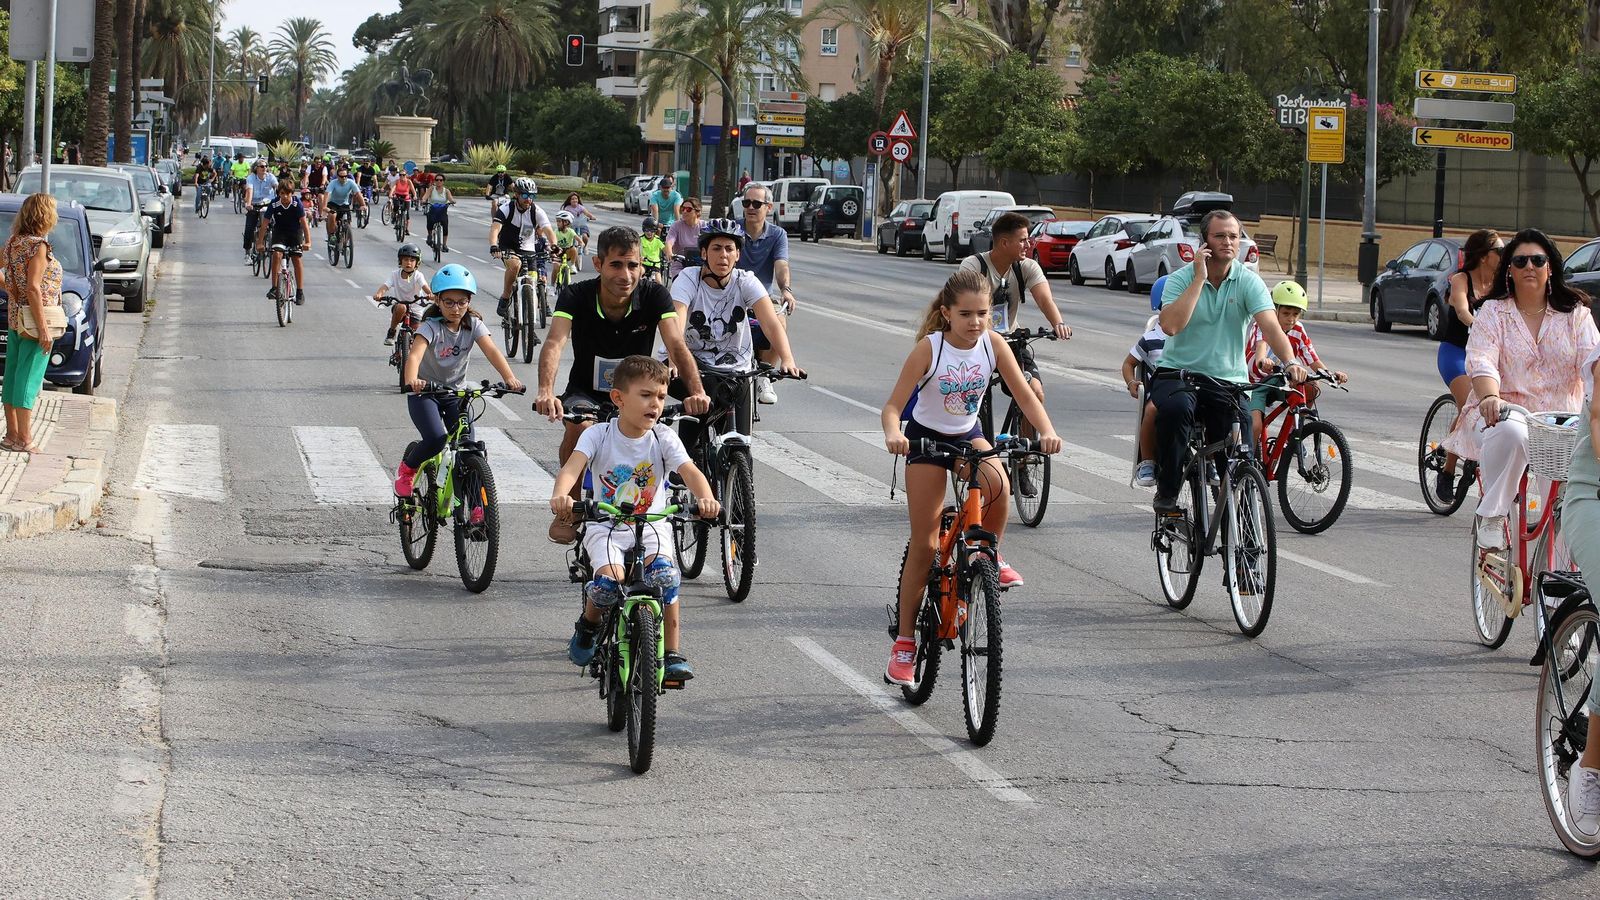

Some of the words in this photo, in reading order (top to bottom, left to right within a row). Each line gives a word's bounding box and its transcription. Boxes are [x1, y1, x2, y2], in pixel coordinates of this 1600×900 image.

[1276, 93, 1347, 108] Restaurante
[1280, 108, 1292, 124] El
[1455, 132, 1509, 146] Alcampo
[894, 147, 907, 155] 30
